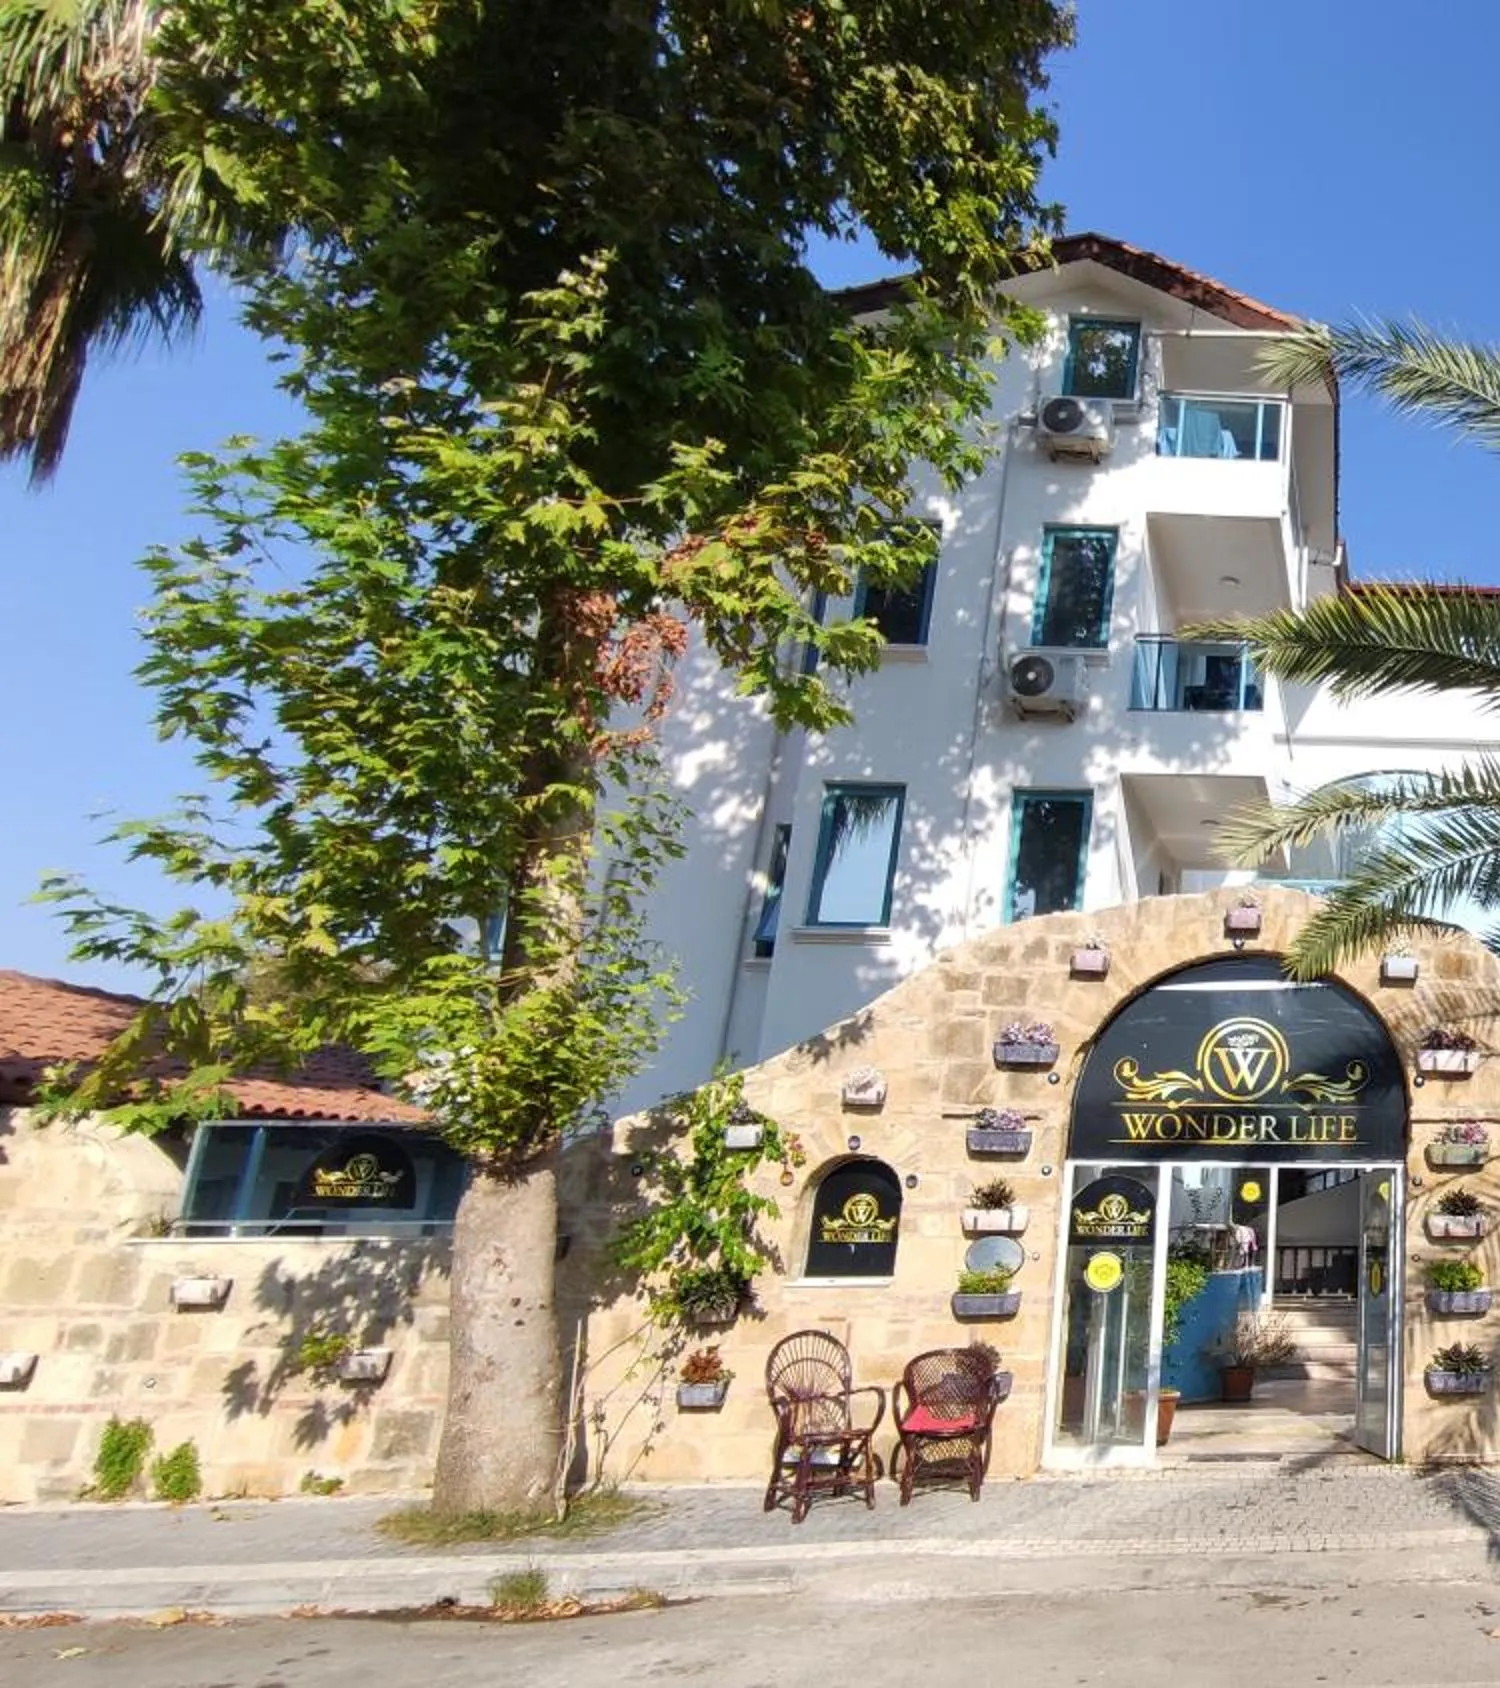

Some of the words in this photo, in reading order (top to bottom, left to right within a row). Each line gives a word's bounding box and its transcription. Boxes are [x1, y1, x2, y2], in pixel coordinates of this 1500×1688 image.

[1214, 1047, 1275, 1091] W
[1121, 1113, 1281, 1140] WONDER
[1289, 1115, 1358, 1141] LIFE
[1076, 1225, 1125, 1236] WONDER
